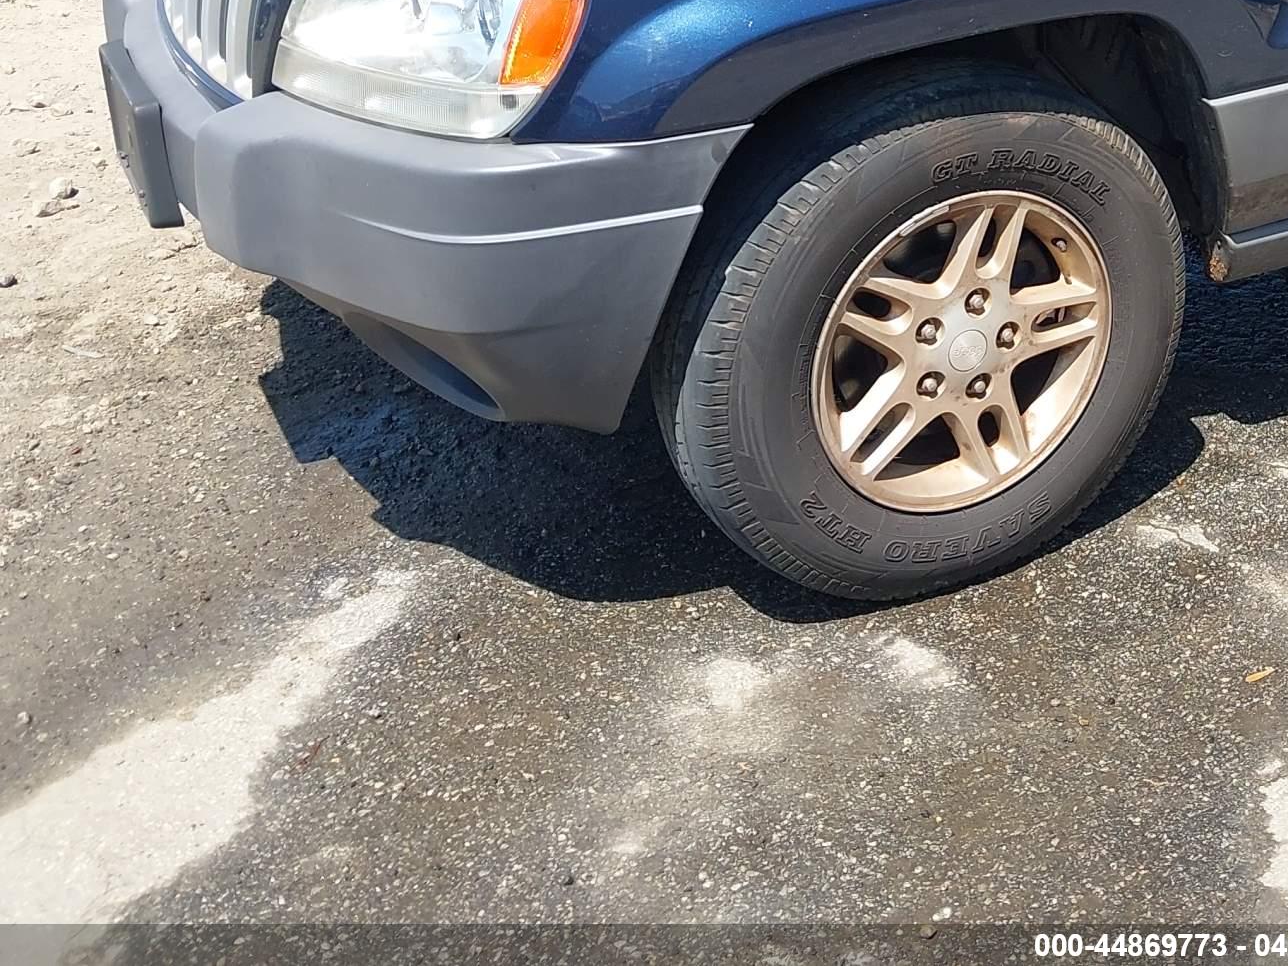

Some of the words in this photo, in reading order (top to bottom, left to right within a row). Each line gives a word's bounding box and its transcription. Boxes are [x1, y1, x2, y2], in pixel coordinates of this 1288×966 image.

[931, 150, 979, 183] GT
[987, 147, 1113, 206] RADIAL
[800, 490, 872, 554] HT2
[883, 489, 1053, 563] SAVERO
